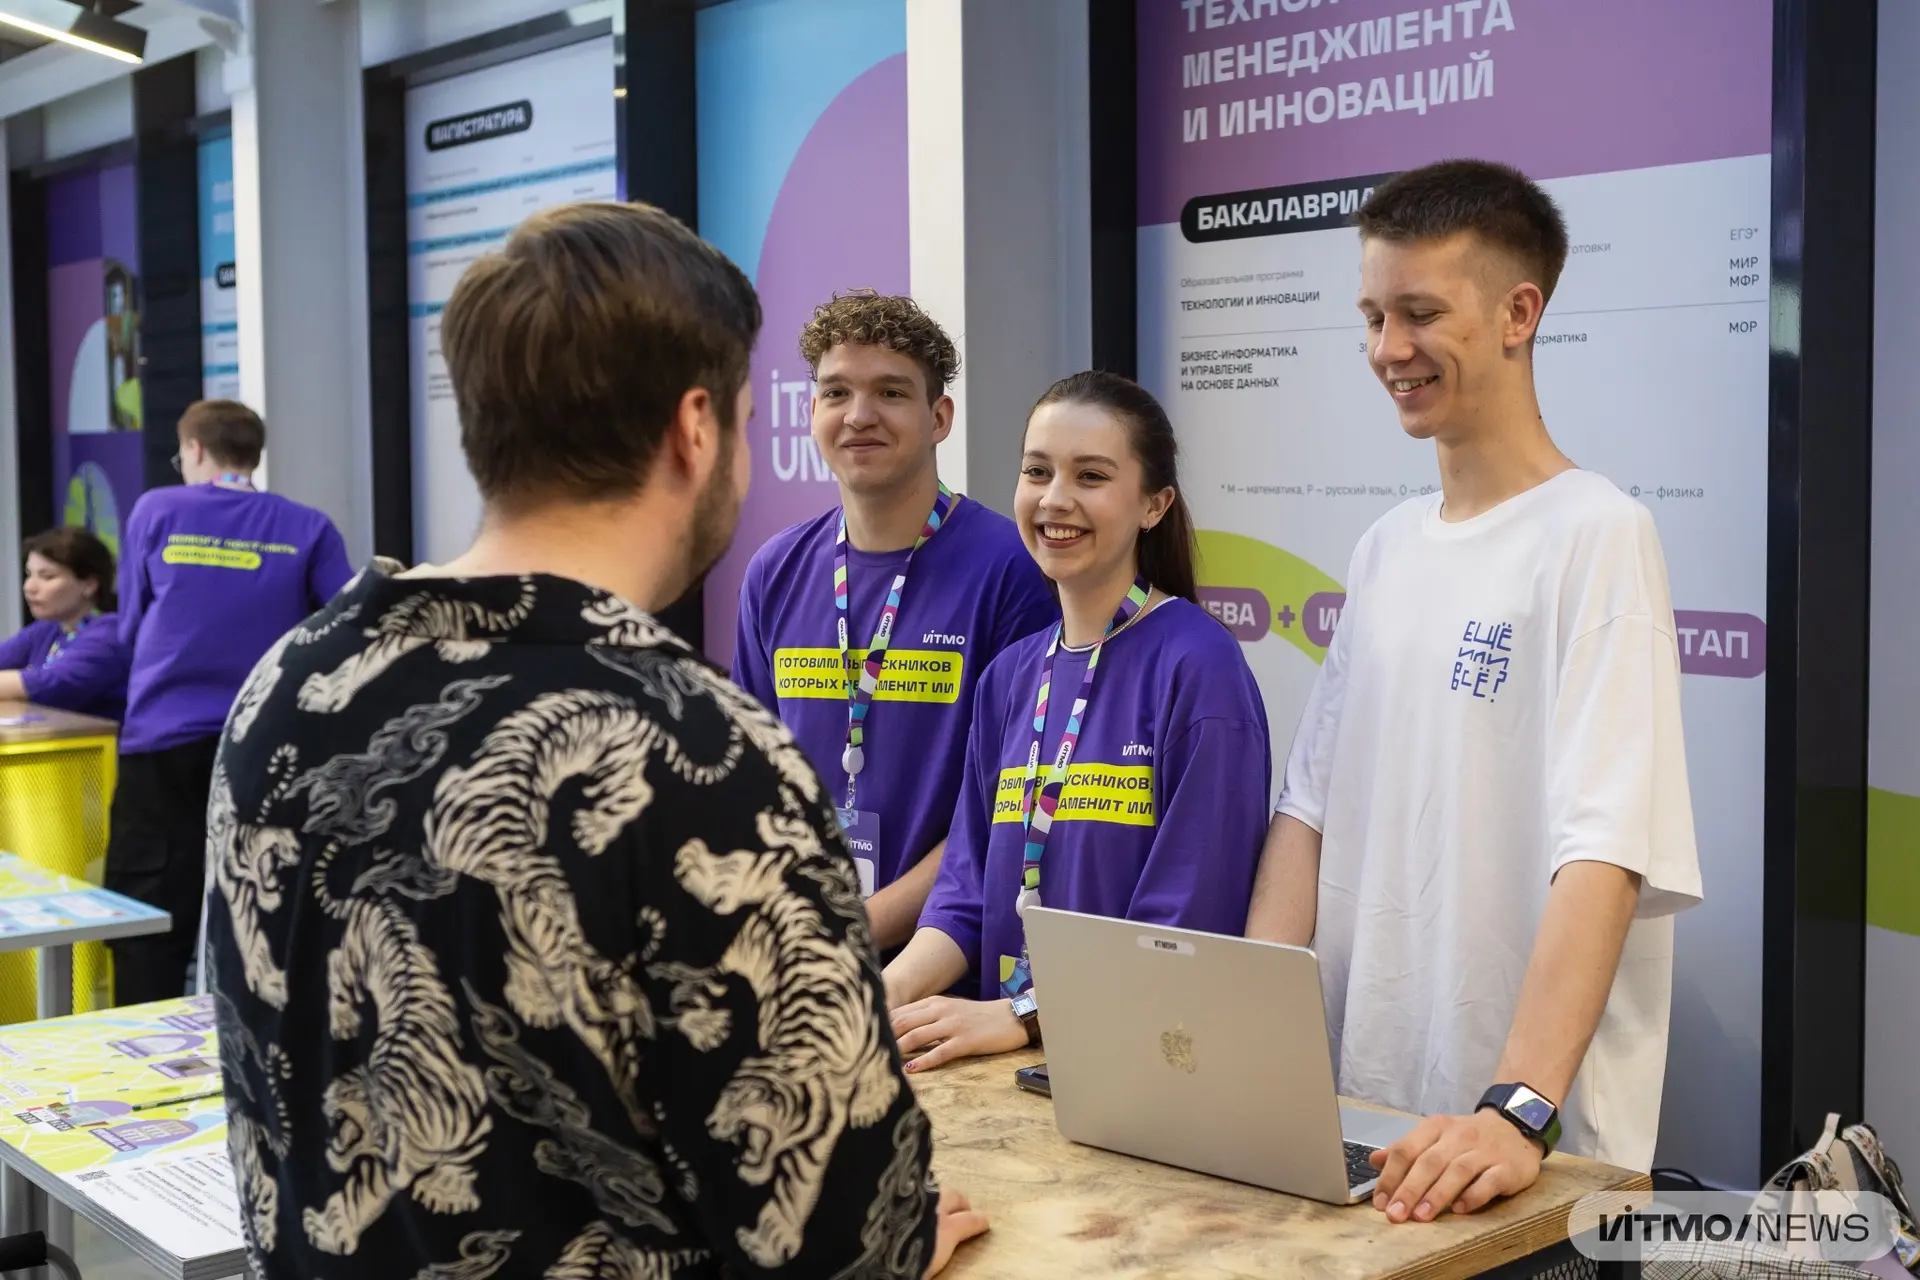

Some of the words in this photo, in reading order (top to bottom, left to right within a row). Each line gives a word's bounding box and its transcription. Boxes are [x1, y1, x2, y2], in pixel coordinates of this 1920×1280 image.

[1182, 0, 1338, 32] ТЕХН
[1183, 0, 1515, 88] МЕНЕДЖМЕНТА
[1183, 106, 1207, 143] И
[1219, 50, 1493, 138] ИННОВАЦИЙ
[1571, 243, 1611, 254] отовки
[1730, 256, 1759, 270] МИР
[1256, 269, 1304, 282] программа
[1729, 274, 1760, 287] МФР
[1181, 296, 1244, 311] ТЕХНОЛОГИИ
[1247, 296, 1254, 306] И
[1256, 291, 1320, 306] ИННОВАЦИИ
[1729, 321, 1758, 333] МОР
[1535, 333, 1588, 347] орматика
[1181, 346, 1298, 362] БИЗНЕС-ИНФОРМАТИКА
[1181, 366, 1188, 376] И
[1190, 363, 1253, 376] УПРАВЛЕНИЕ
[1181, 380, 1194, 390] НА
[1196, 379, 1234, 390] ОСНОВЕ
[1237, 377, 1279, 389] ДАННЫХ
[771, 435, 838, 482] UN
[1656, 485, 1705, 500] физика
[1203, 600, 1256, 627] ЕВА
[1678, 627, 1749, 659] ТАП
[779, 657, 838, 669] ГОТОВИМ
[842, 658, 951, 673] ВЫСКНИКОВ
[779, 678, 838, 690] КОТОРЫХ
[874, 680, 927, 692] МЕНИТ
[932, 682, 954, 694] ИИ
[1058, 797, 1123, 811] АМЕНИТ
[1127, 802, 1152, 814] ИИ
